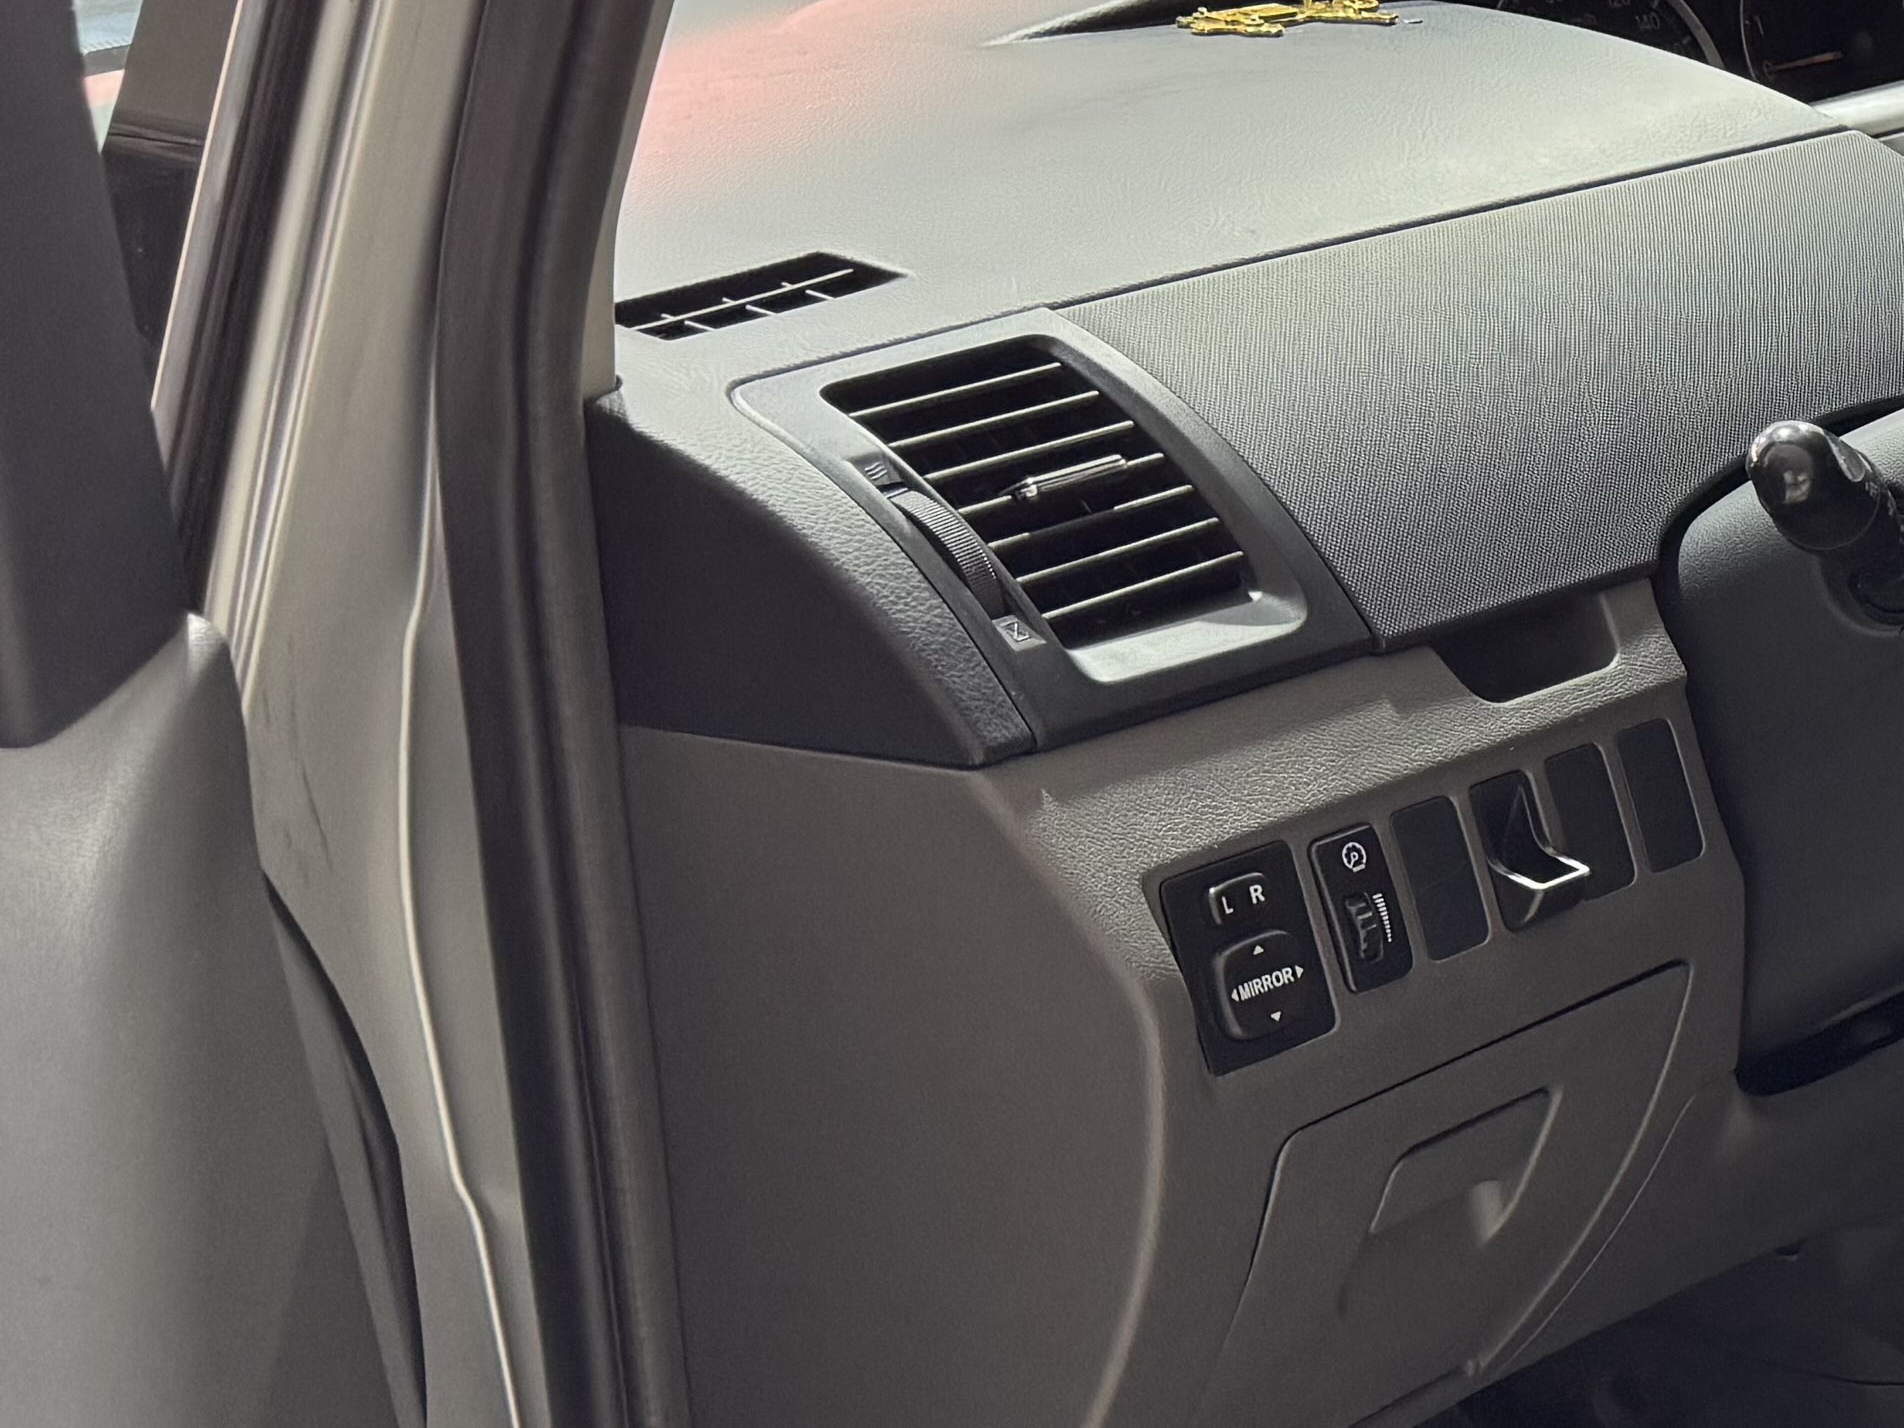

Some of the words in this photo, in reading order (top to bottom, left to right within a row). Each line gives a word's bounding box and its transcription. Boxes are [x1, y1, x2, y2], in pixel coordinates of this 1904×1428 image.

[1221, 896, 1234, 915] L
[1249, 883, 1266, 905] R
[1238, 966, 1295, 1002] MIRROR
